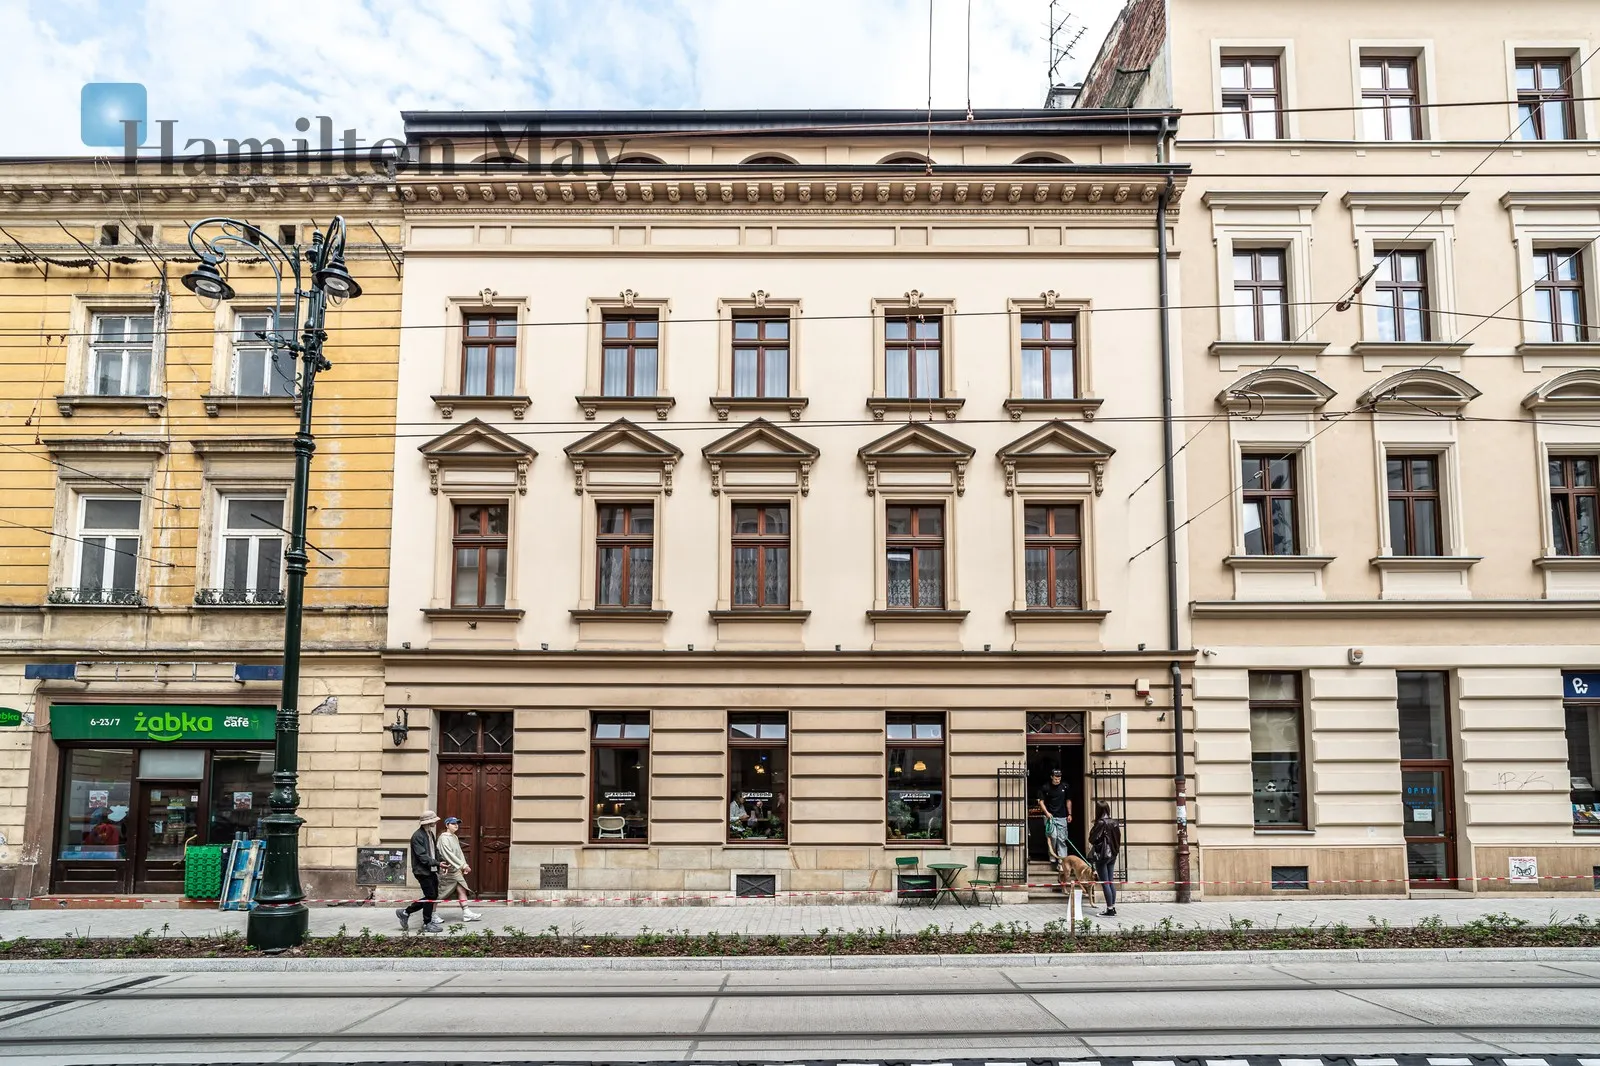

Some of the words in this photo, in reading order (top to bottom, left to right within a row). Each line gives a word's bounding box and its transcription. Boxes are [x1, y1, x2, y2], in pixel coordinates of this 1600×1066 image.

[0, 712, 20, 721] bka
[90, 718, 121, 727] 6-23/7
[134, 711, 213, 732] żabka
